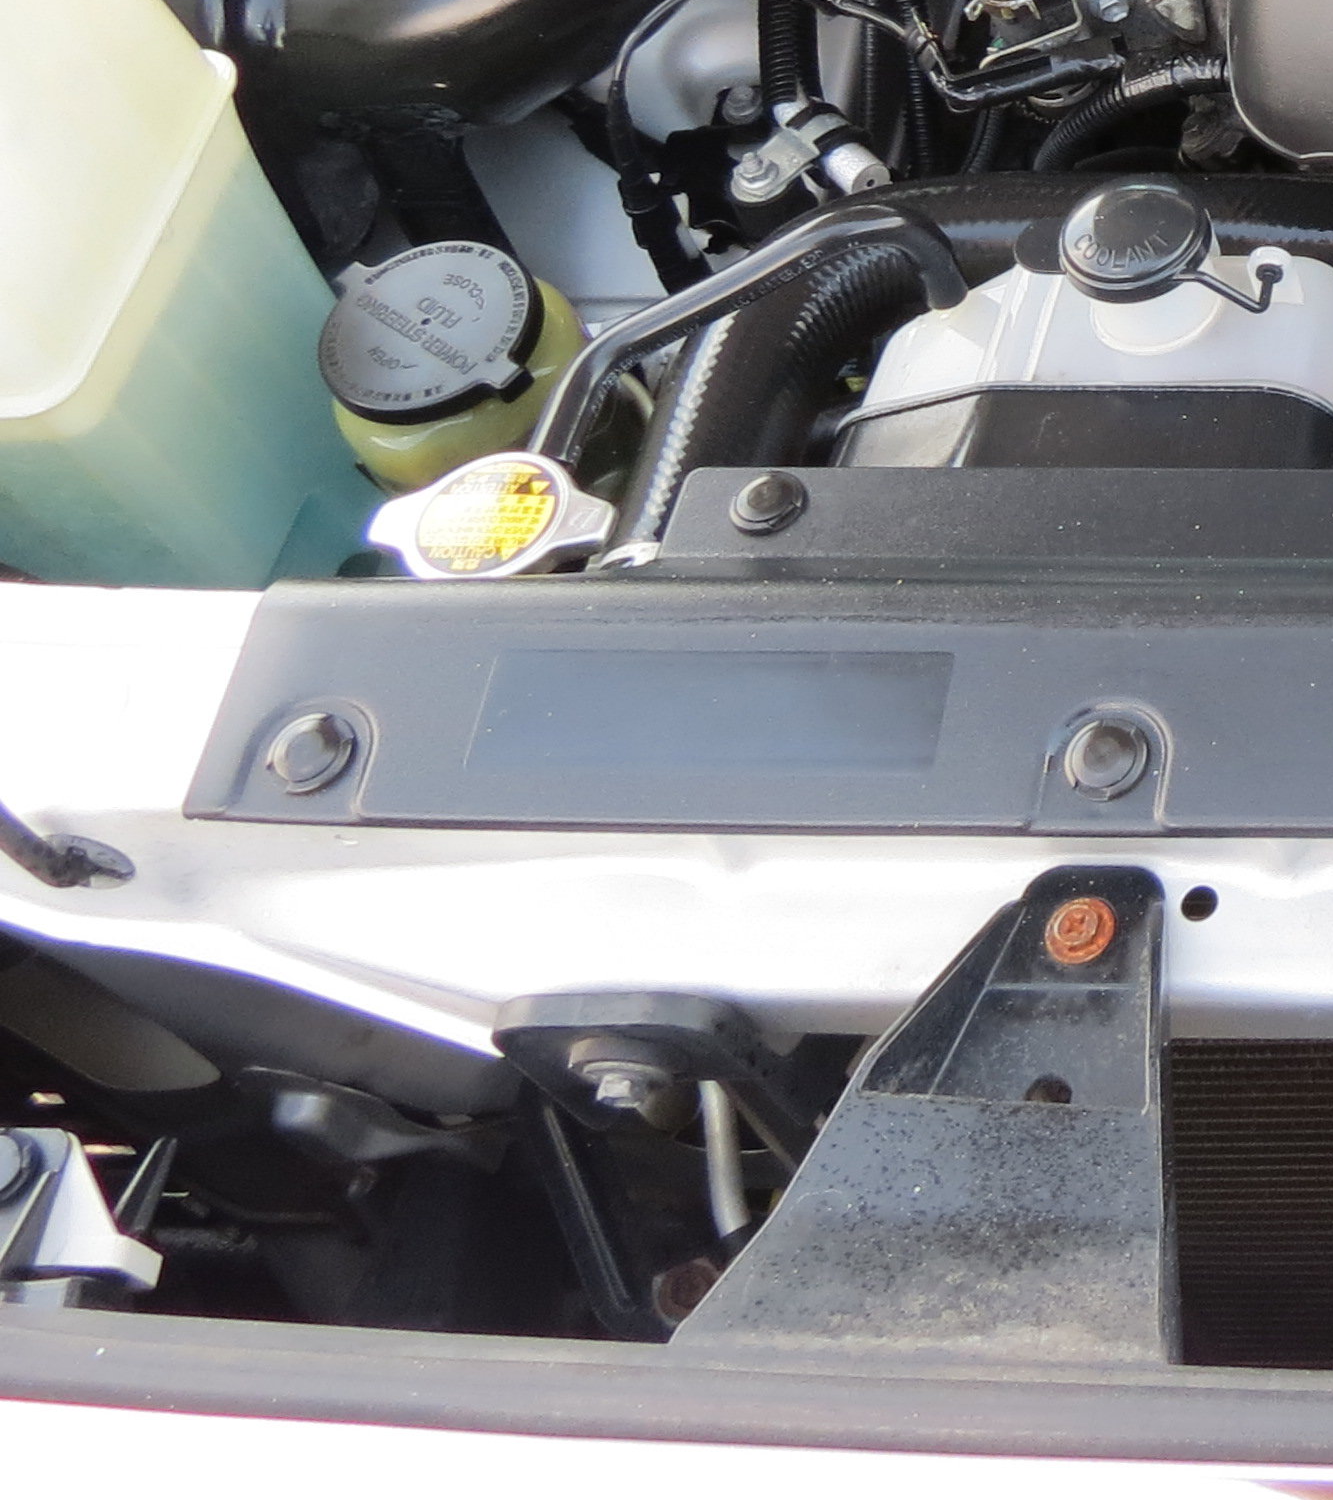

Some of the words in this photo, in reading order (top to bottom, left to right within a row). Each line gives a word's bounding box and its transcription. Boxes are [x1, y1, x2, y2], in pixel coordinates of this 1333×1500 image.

[1074, 233, 1168, 269] COOLANT
[441, 272, 484, 299] CLOSE
[355, 294, 427, 343] STEERING
[416, 296, 463, 330] FLUID
[366, 345, 402, 370] OPEN
[421, 328, 478, 376] POWER
[428, 546, 496, 560] CAUTION
